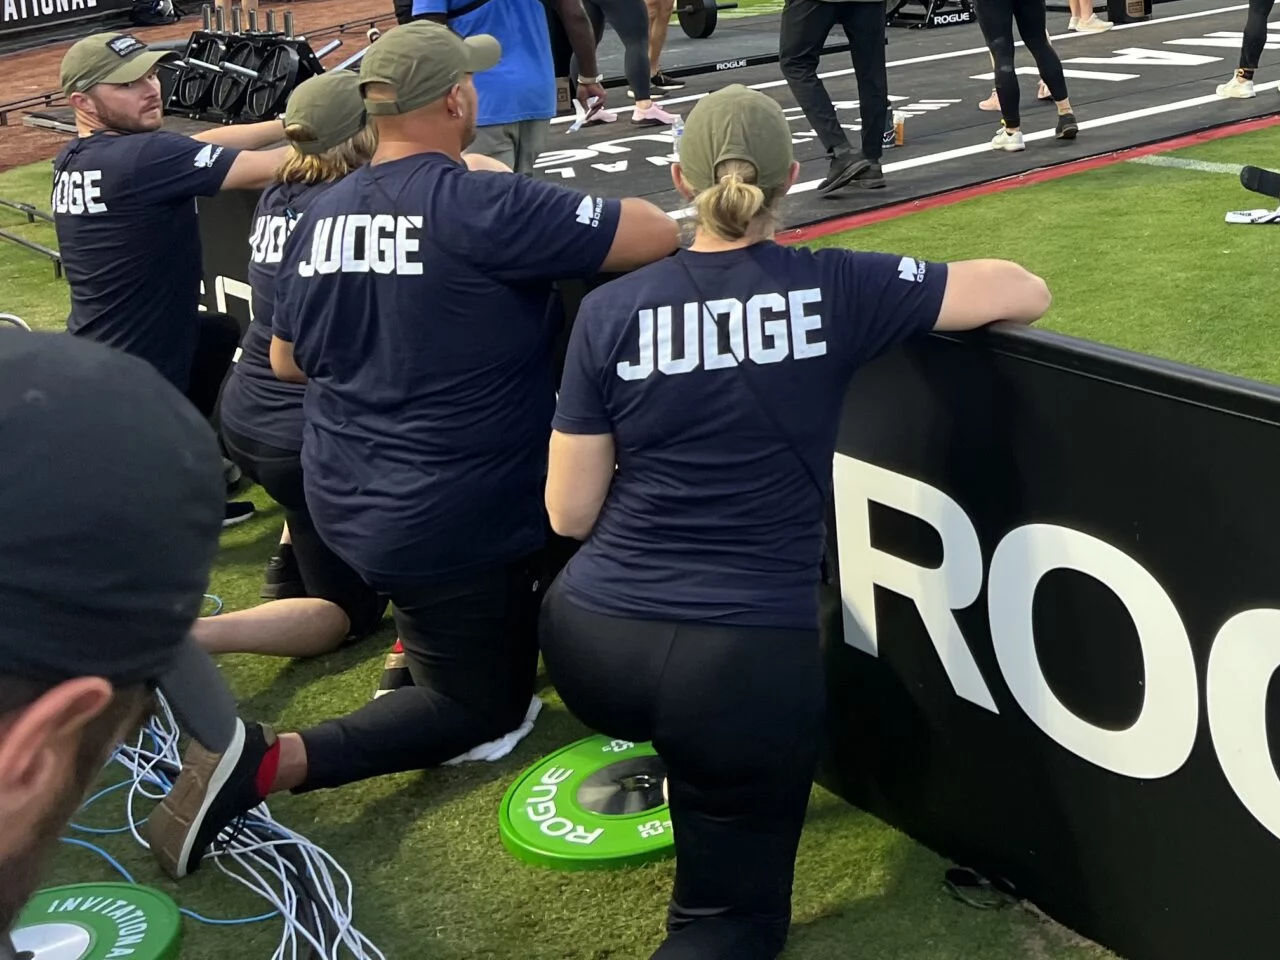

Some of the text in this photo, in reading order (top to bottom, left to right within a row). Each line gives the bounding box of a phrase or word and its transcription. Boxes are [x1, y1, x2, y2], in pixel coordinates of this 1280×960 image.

[933, 12, 970, 25] ROGUE
[716, 59, 747, 71] ROGUE
[298, 214, 424, 277] JUDGE
[616, 287, 827, 381] JUDGE
[526, 765, 605, 845] ROGUE
[47, 896, 148, 960] INVITATIONA
